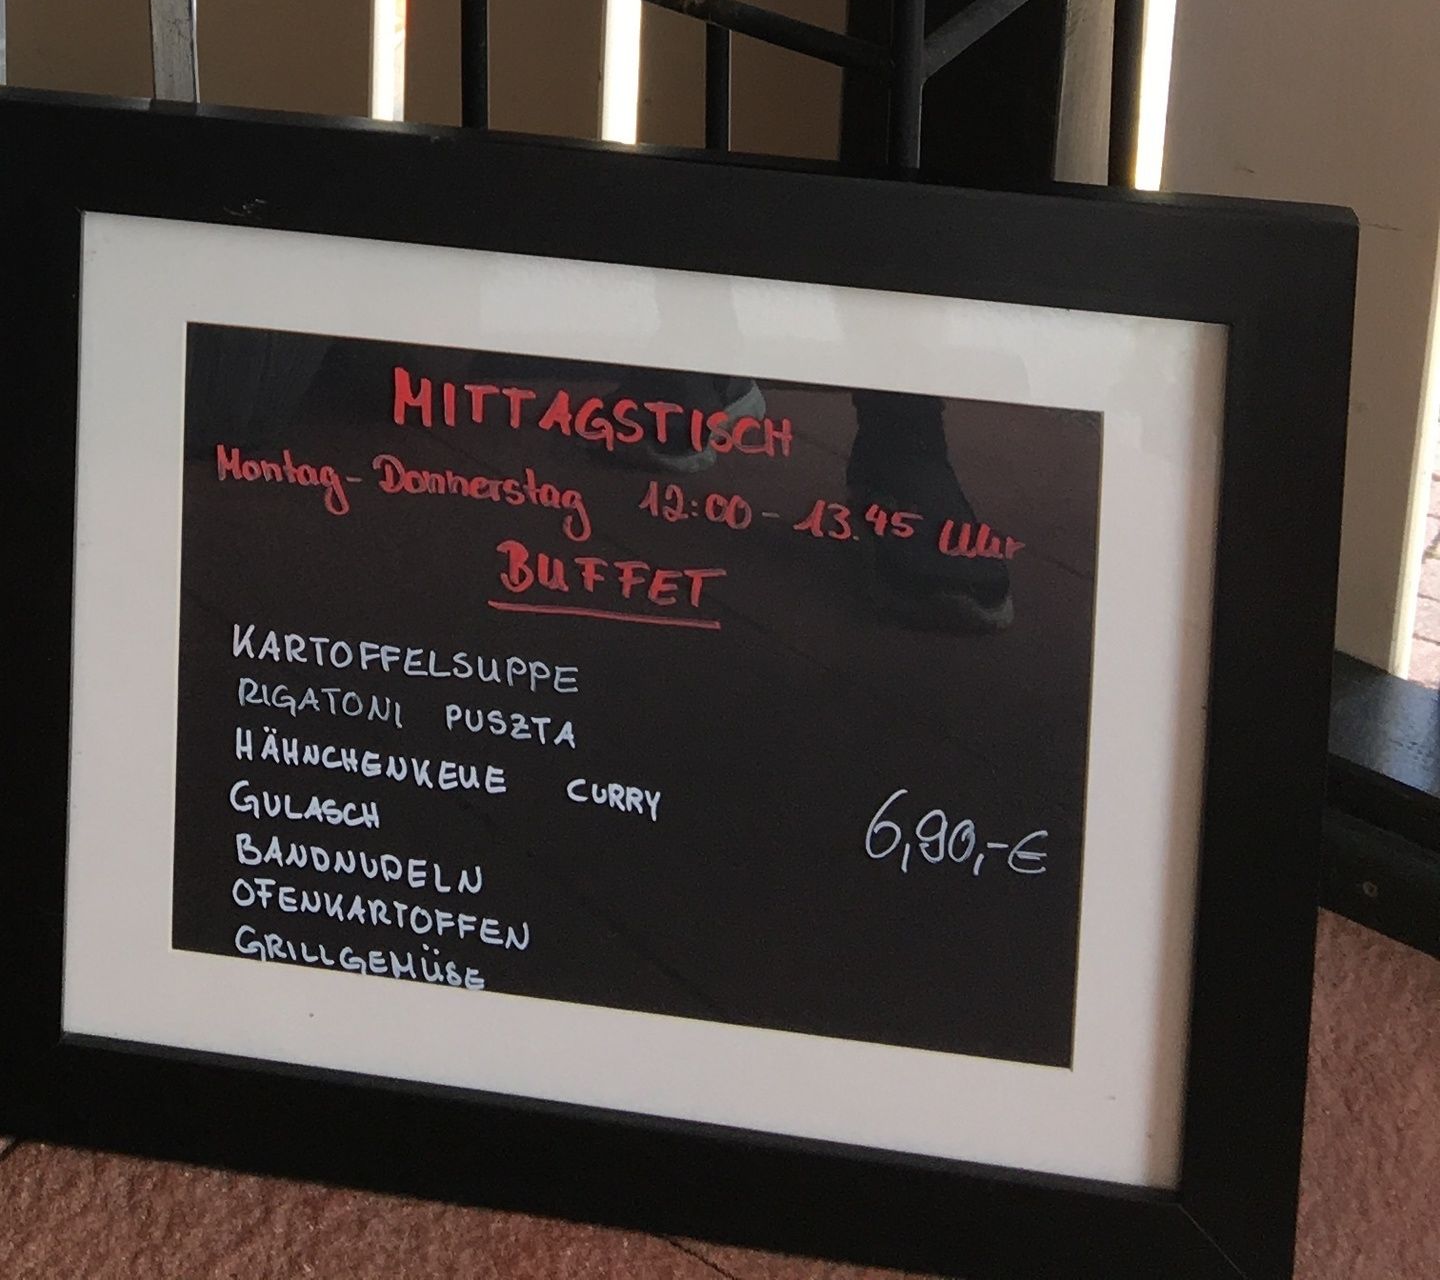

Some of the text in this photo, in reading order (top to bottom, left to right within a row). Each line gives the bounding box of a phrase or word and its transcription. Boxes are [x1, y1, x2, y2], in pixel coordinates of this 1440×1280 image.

[394, 367, 793, 458] MITTAGSTISCH
[938, 518, 1026, 559] Uhr
[496, 540, 726, 607] BUFFET
[232, 624, 579, 694] KARTOFFELSUPPE
[238, 678, 576, 749] RIGATONI PUSZTA
[229, 780, 380, 829] GULASCH
[567, 779, 660, 821] CURRY
[236, 833, 483, 894] BANDNUDELN
[232, 878, 529, 951] OFENKARTOFFEN
[235, 924, 485, 991] GRILLGEMÜSE
